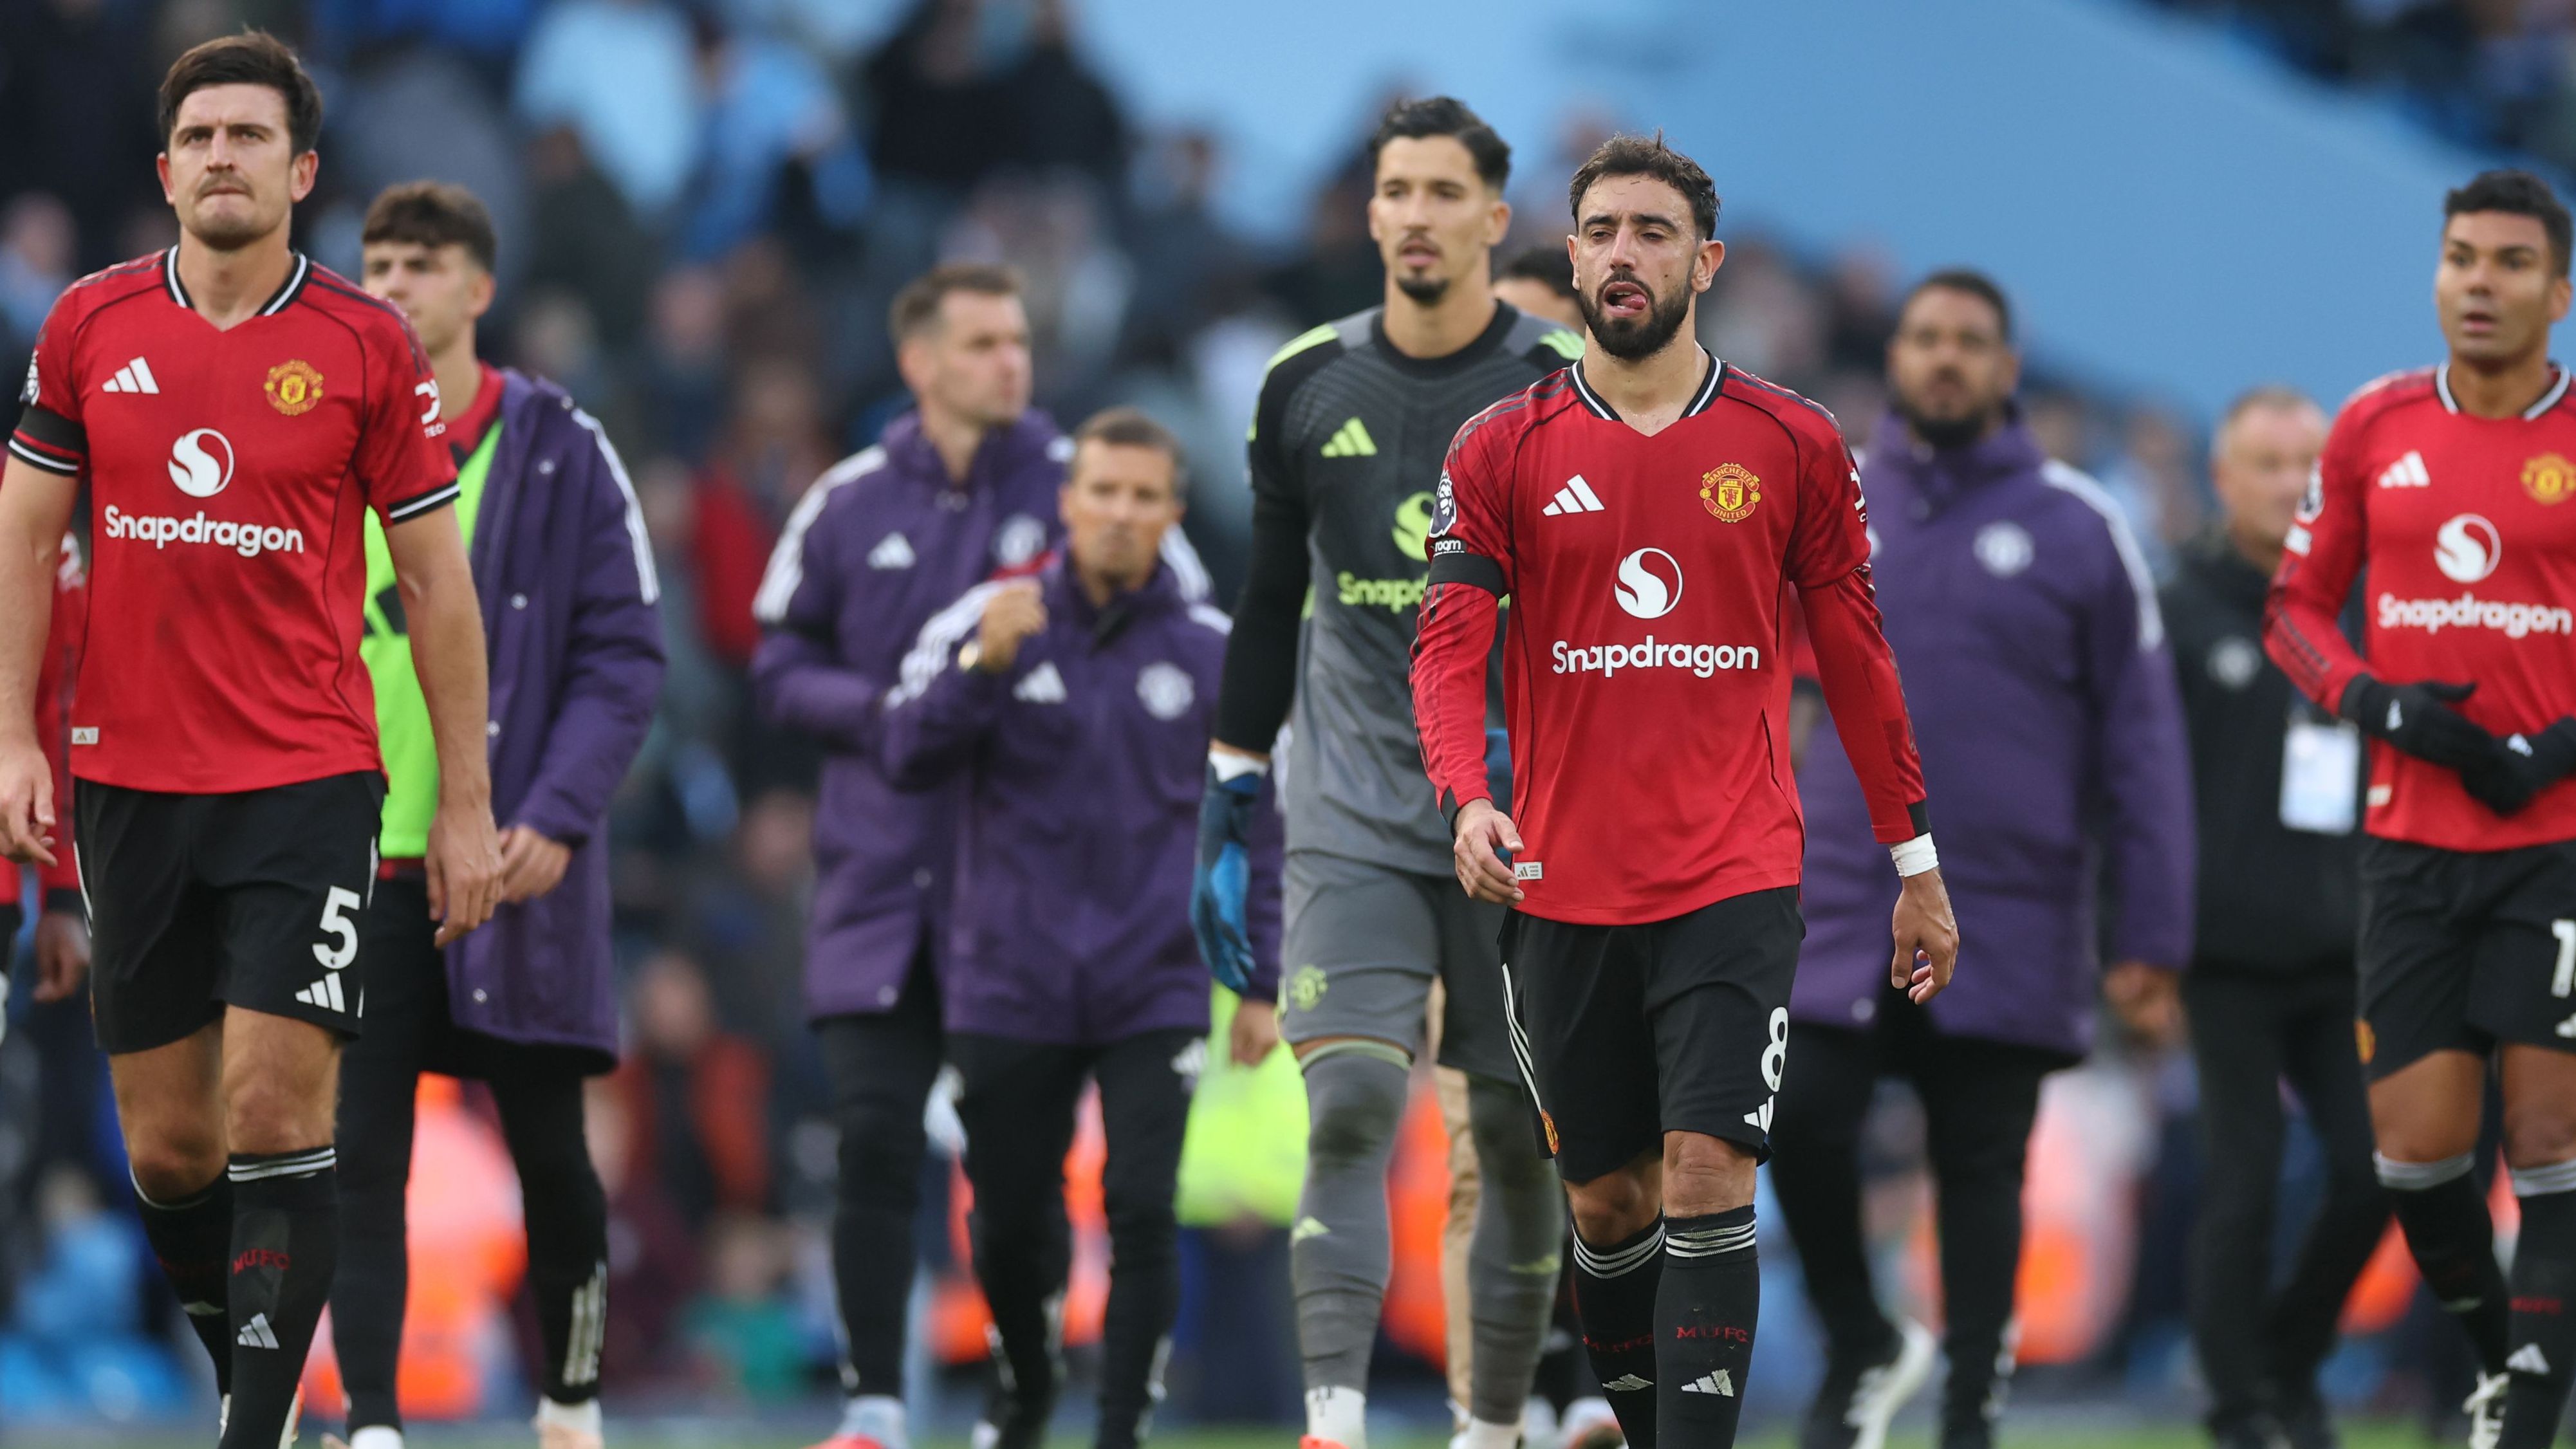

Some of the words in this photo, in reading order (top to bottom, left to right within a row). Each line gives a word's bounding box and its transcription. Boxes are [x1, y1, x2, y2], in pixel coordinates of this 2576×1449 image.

[1706, 467, 1756, 488] MANCHESTER
[104, 504, 304, 557] Snapdragon
[1713, 507, 1747, 519] UNITED
[2378, 591, 2573, 639] Snapdragon
[1552, 635, 1759, 678] Snapdragon
[311, 885, 360, 970] 5
[1761, 1006, 1788, 1093] 8
[1676, 1326, 1748, 1343] MUFC
